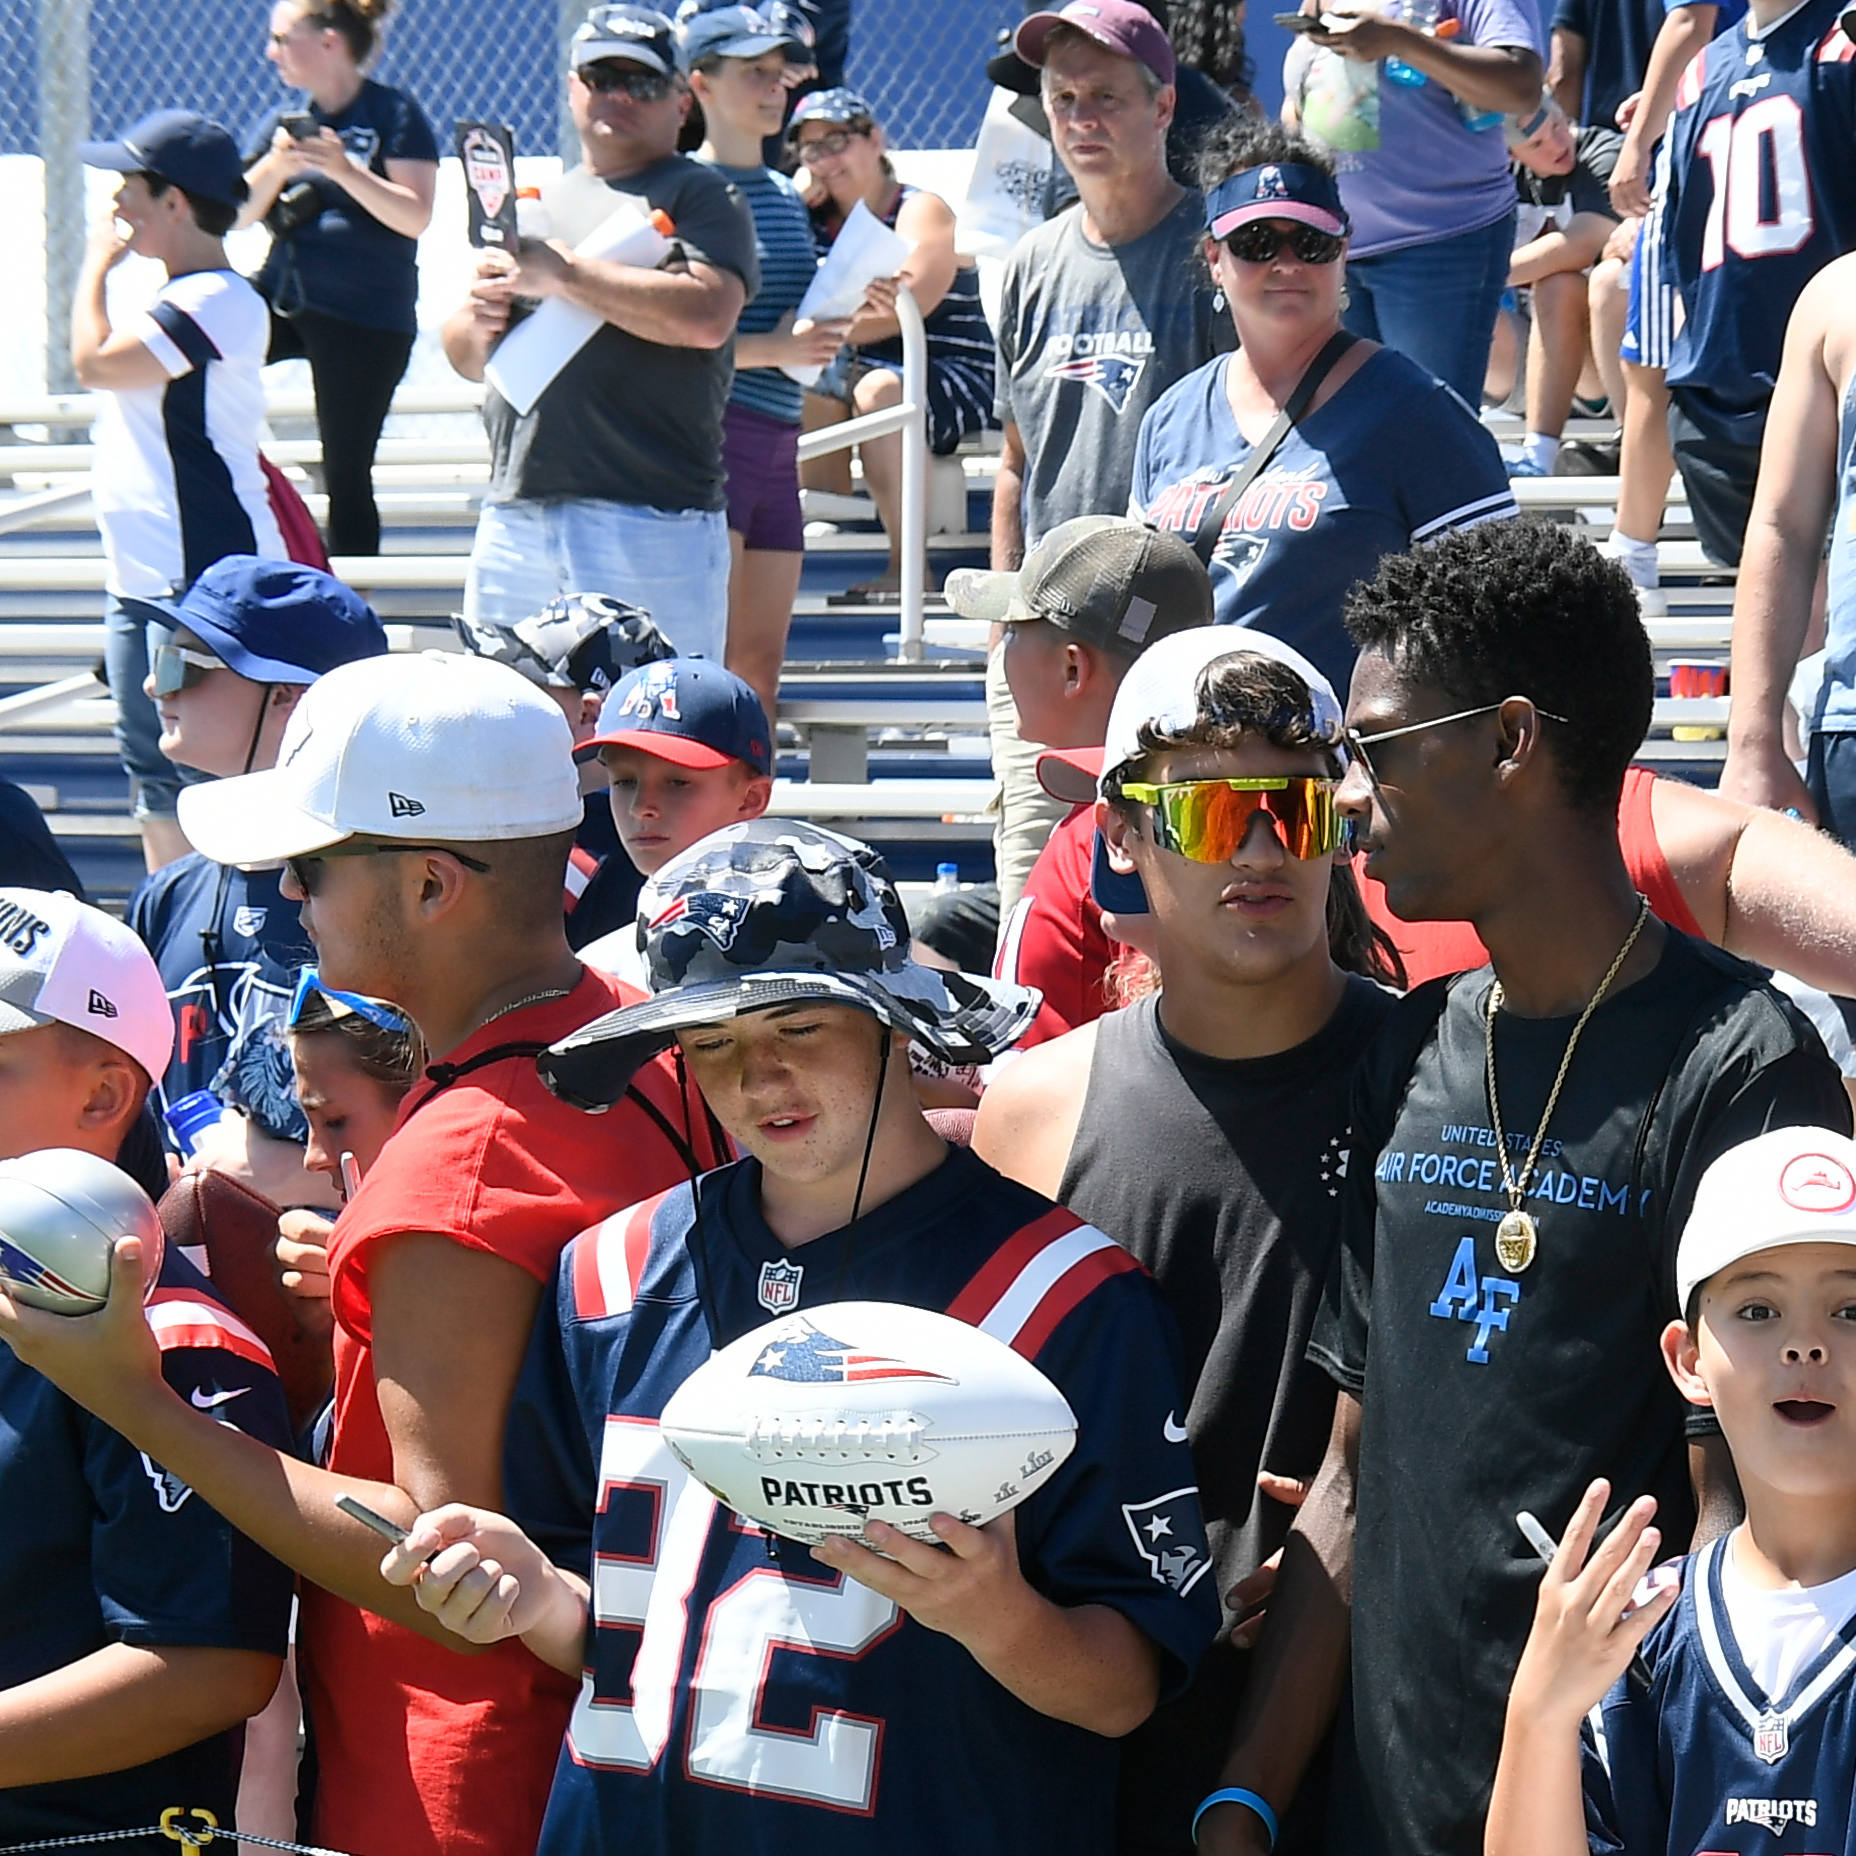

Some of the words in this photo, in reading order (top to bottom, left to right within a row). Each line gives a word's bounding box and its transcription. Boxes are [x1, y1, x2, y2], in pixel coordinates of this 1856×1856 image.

[1698, 94, 1814, 273] 10
[1440, 1124, 1497, 1148] UNITED
[1374, 1153, 1403, 1184] AIR
[1407, 1153, 1497, 1192] FORCE
[764, 1280, 794, 1305] NFL
[1429, 1236, 1522, 1365] AF
[759, 1475, 934, 1508] PATRIOTS
[1726, 1797, 1818, 1831] PATRIOTS
